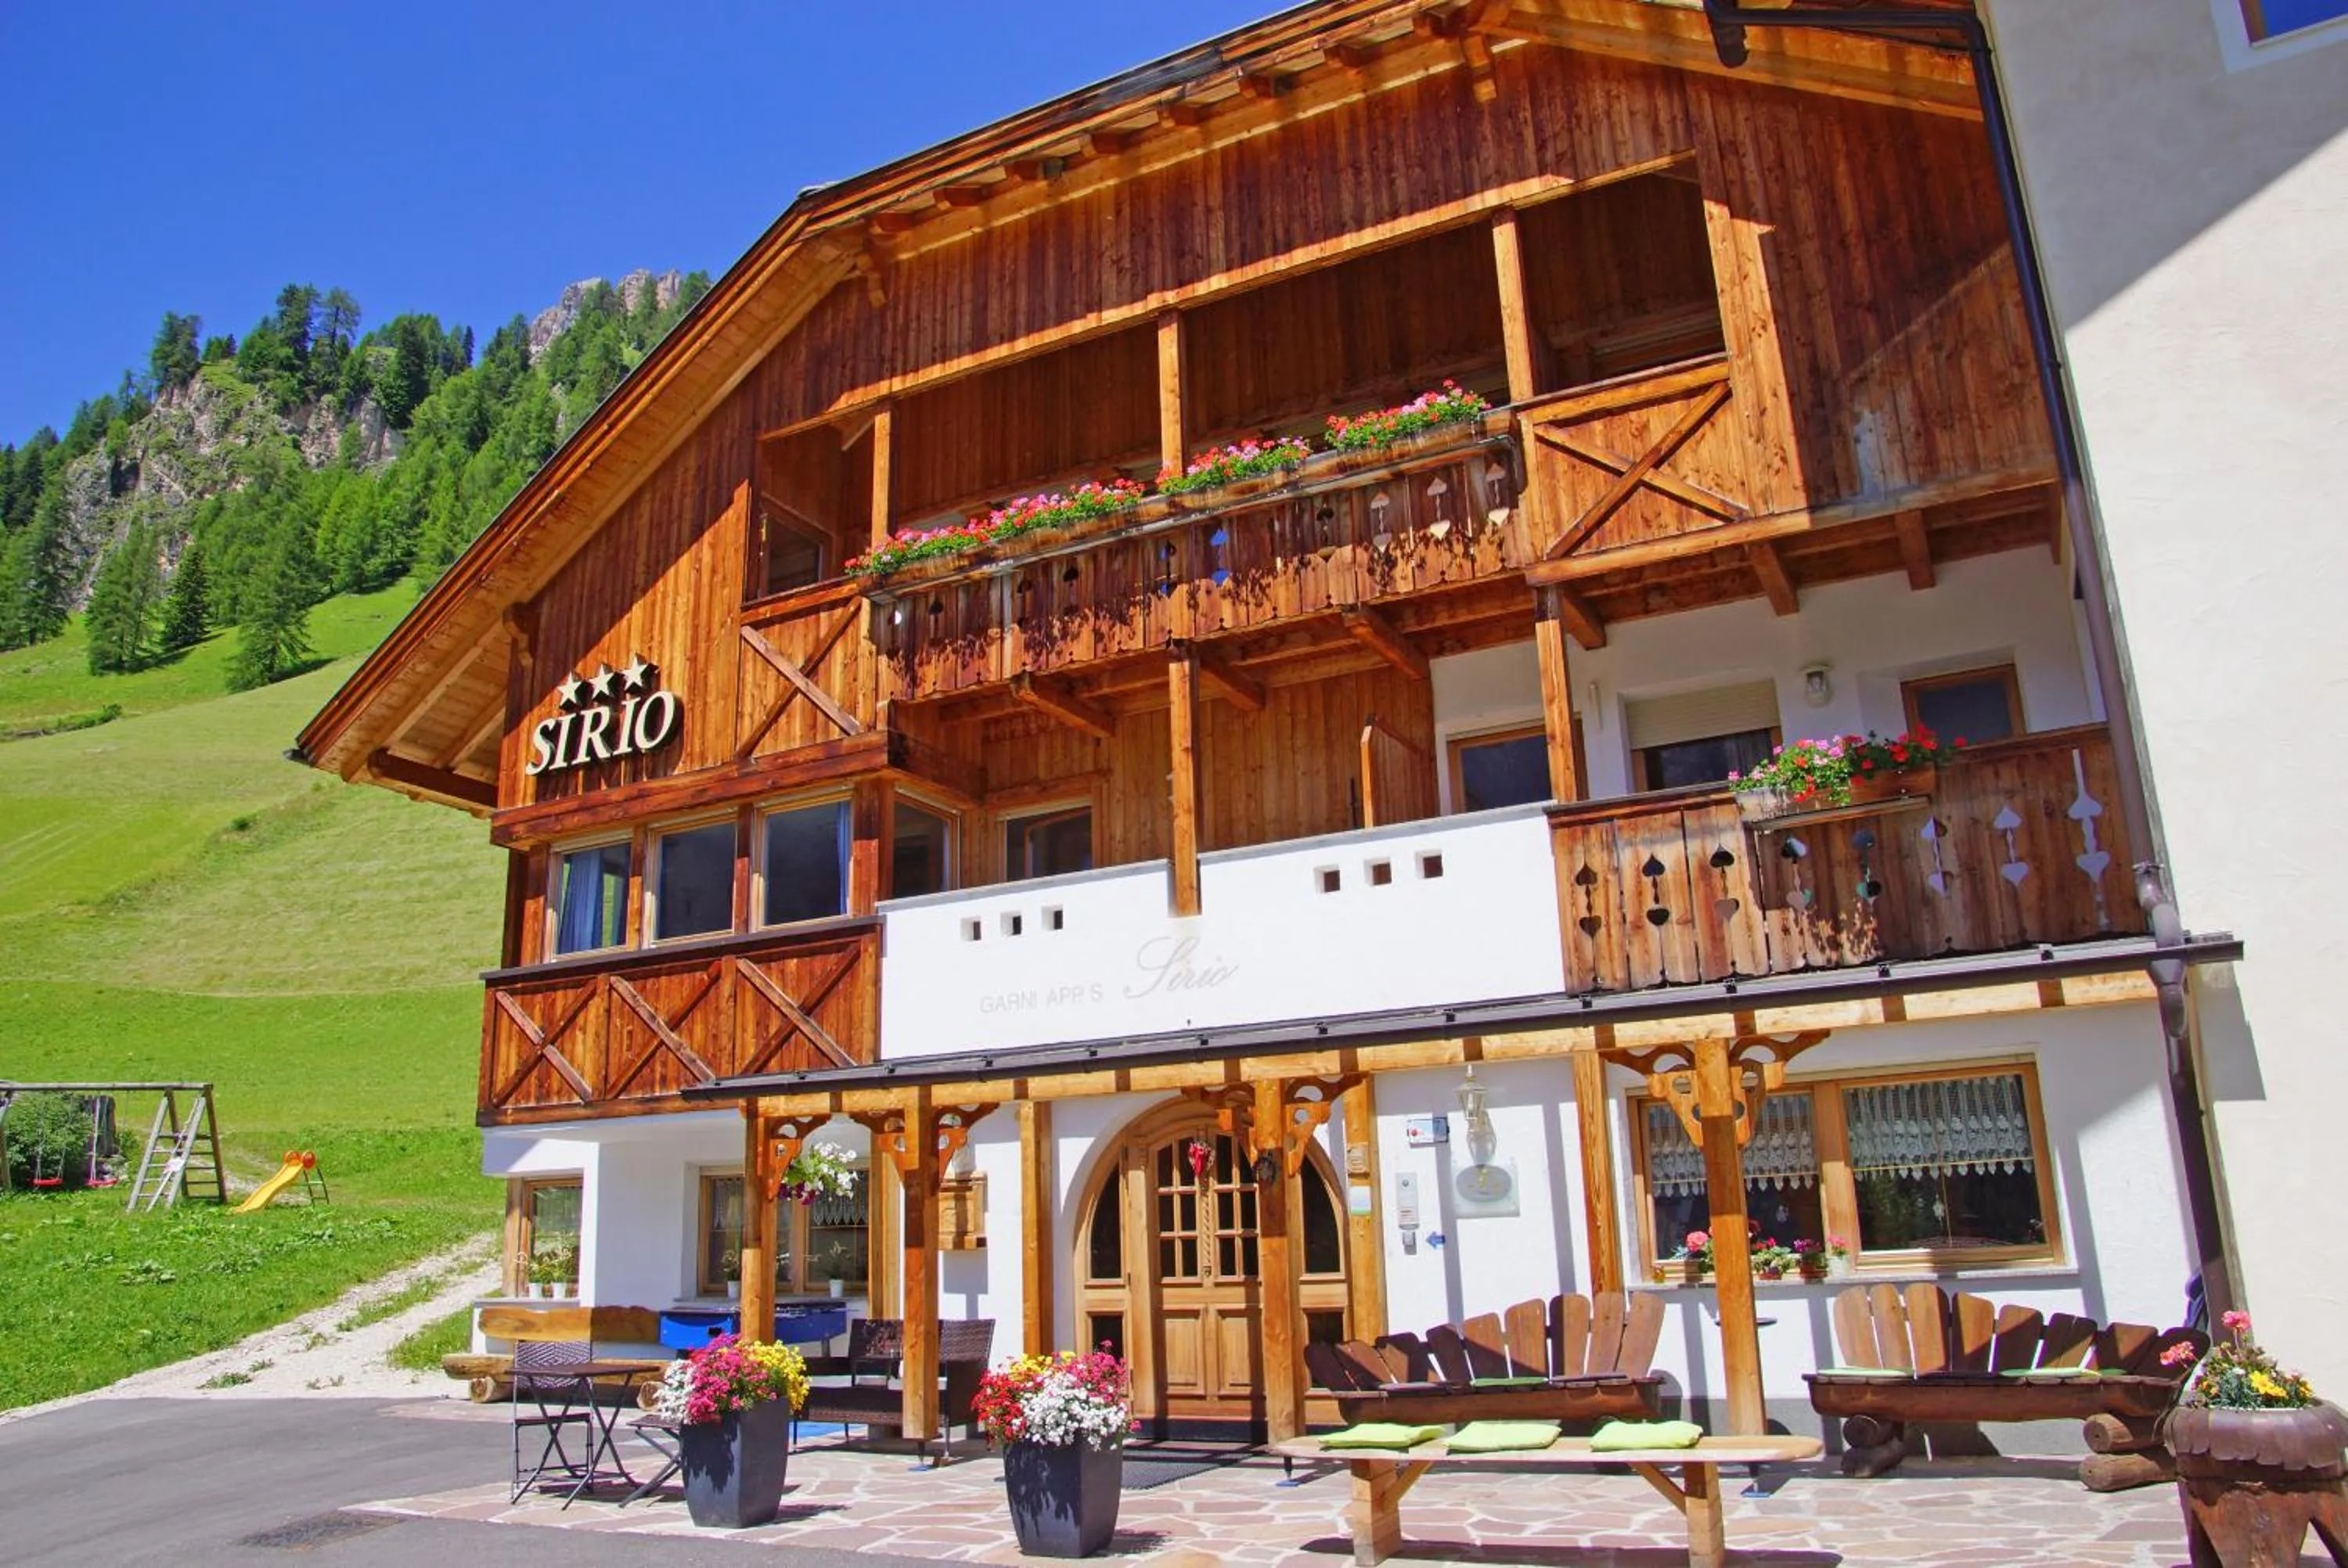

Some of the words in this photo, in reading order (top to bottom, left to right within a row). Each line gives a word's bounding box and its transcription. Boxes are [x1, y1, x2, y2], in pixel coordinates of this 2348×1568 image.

[525, 690, 675, 776] SIRIO
[980, 990, 1038, 1014] GARNI
[1123, 936, 1239, 999] Sirio
